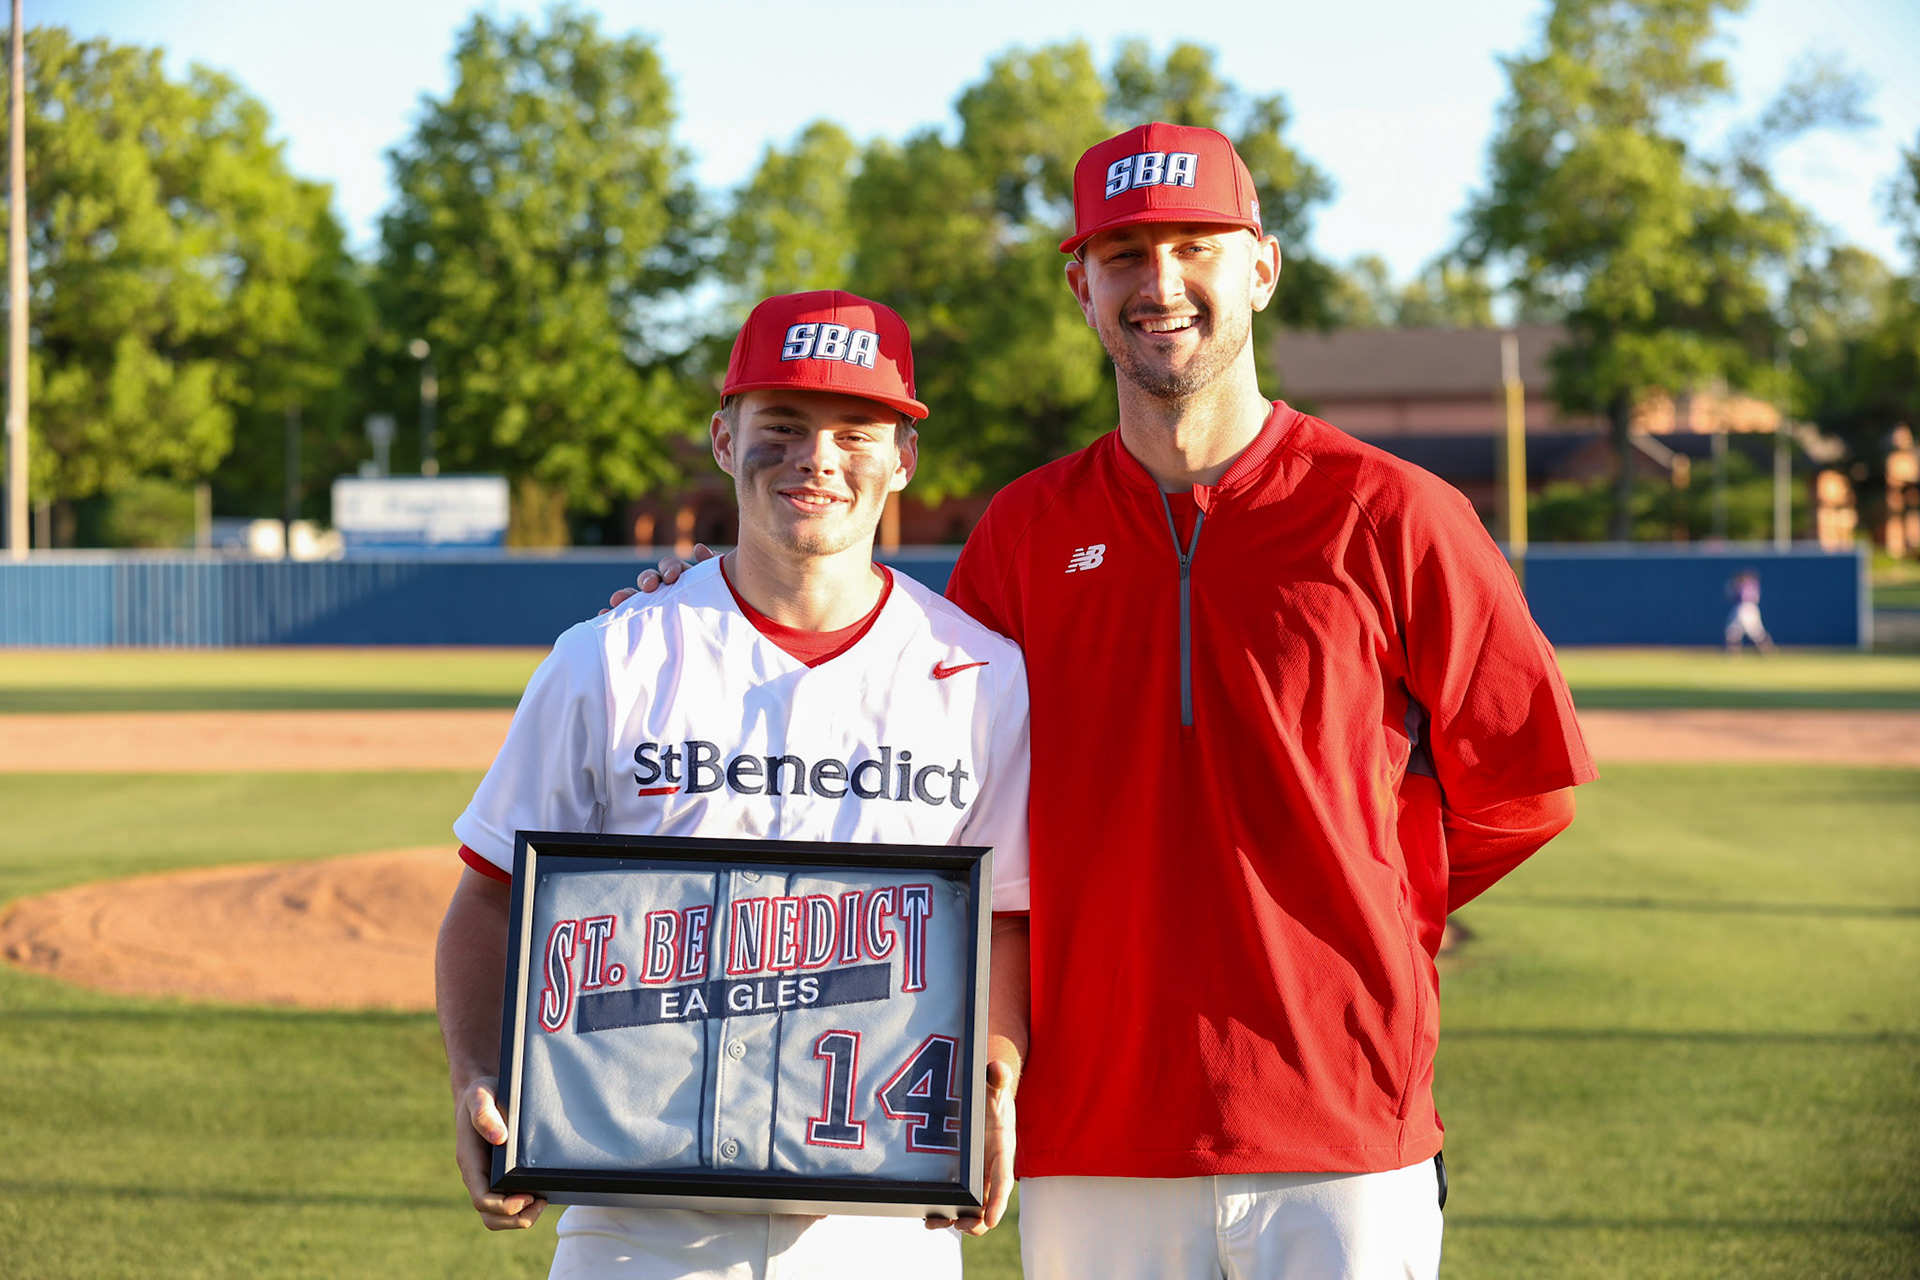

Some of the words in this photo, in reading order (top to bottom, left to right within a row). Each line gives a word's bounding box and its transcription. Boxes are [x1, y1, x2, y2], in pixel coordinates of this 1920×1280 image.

[1105, 151, 1199, 200] SBA
[781, 323, 880, 370] SBA
[539, 914, 627, 1032] ST.
[640, 883, 933, 994] BENEDICT
[806, 1029, 961, 1154] 14
